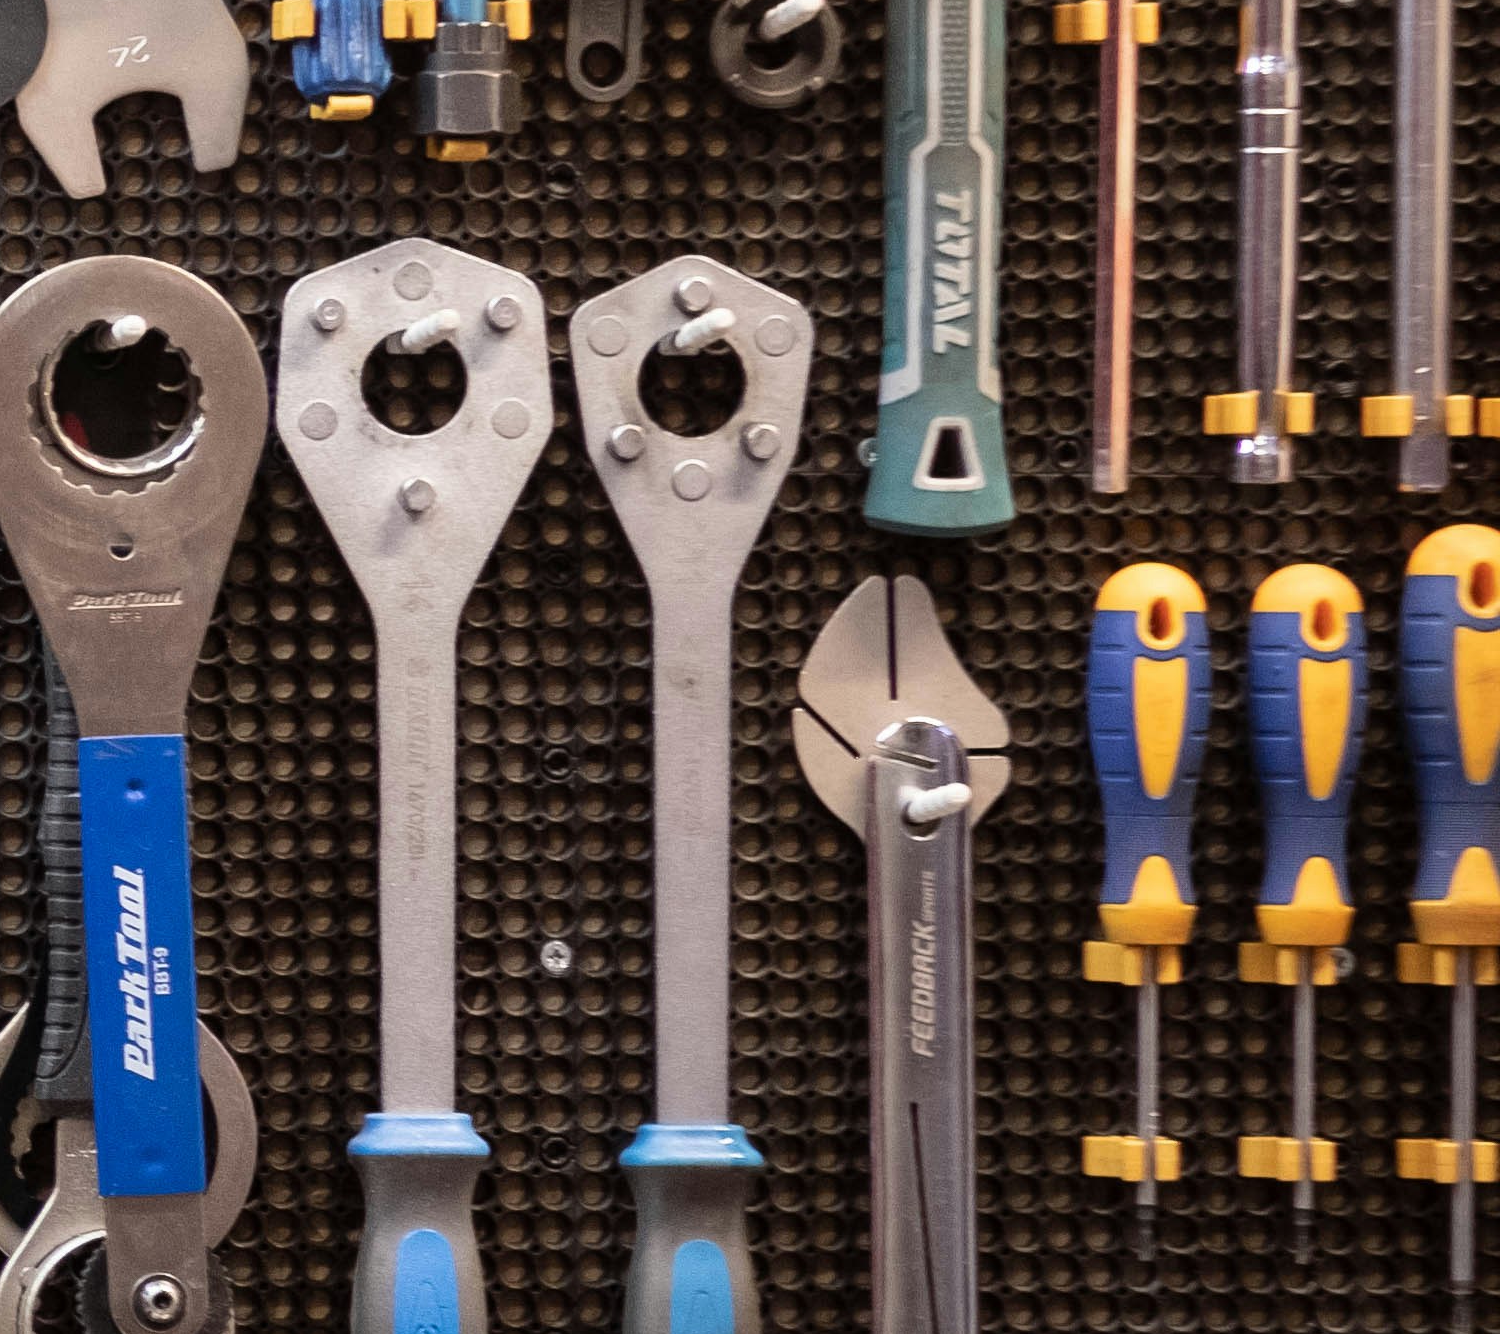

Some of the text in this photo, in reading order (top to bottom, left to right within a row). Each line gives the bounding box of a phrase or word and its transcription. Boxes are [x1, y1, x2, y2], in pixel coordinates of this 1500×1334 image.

[932, 189, 973, 354] TOTAL
[153, 947, 172, 995] BBT-9
[911, 920, 936, 1058] FEEDBACK
